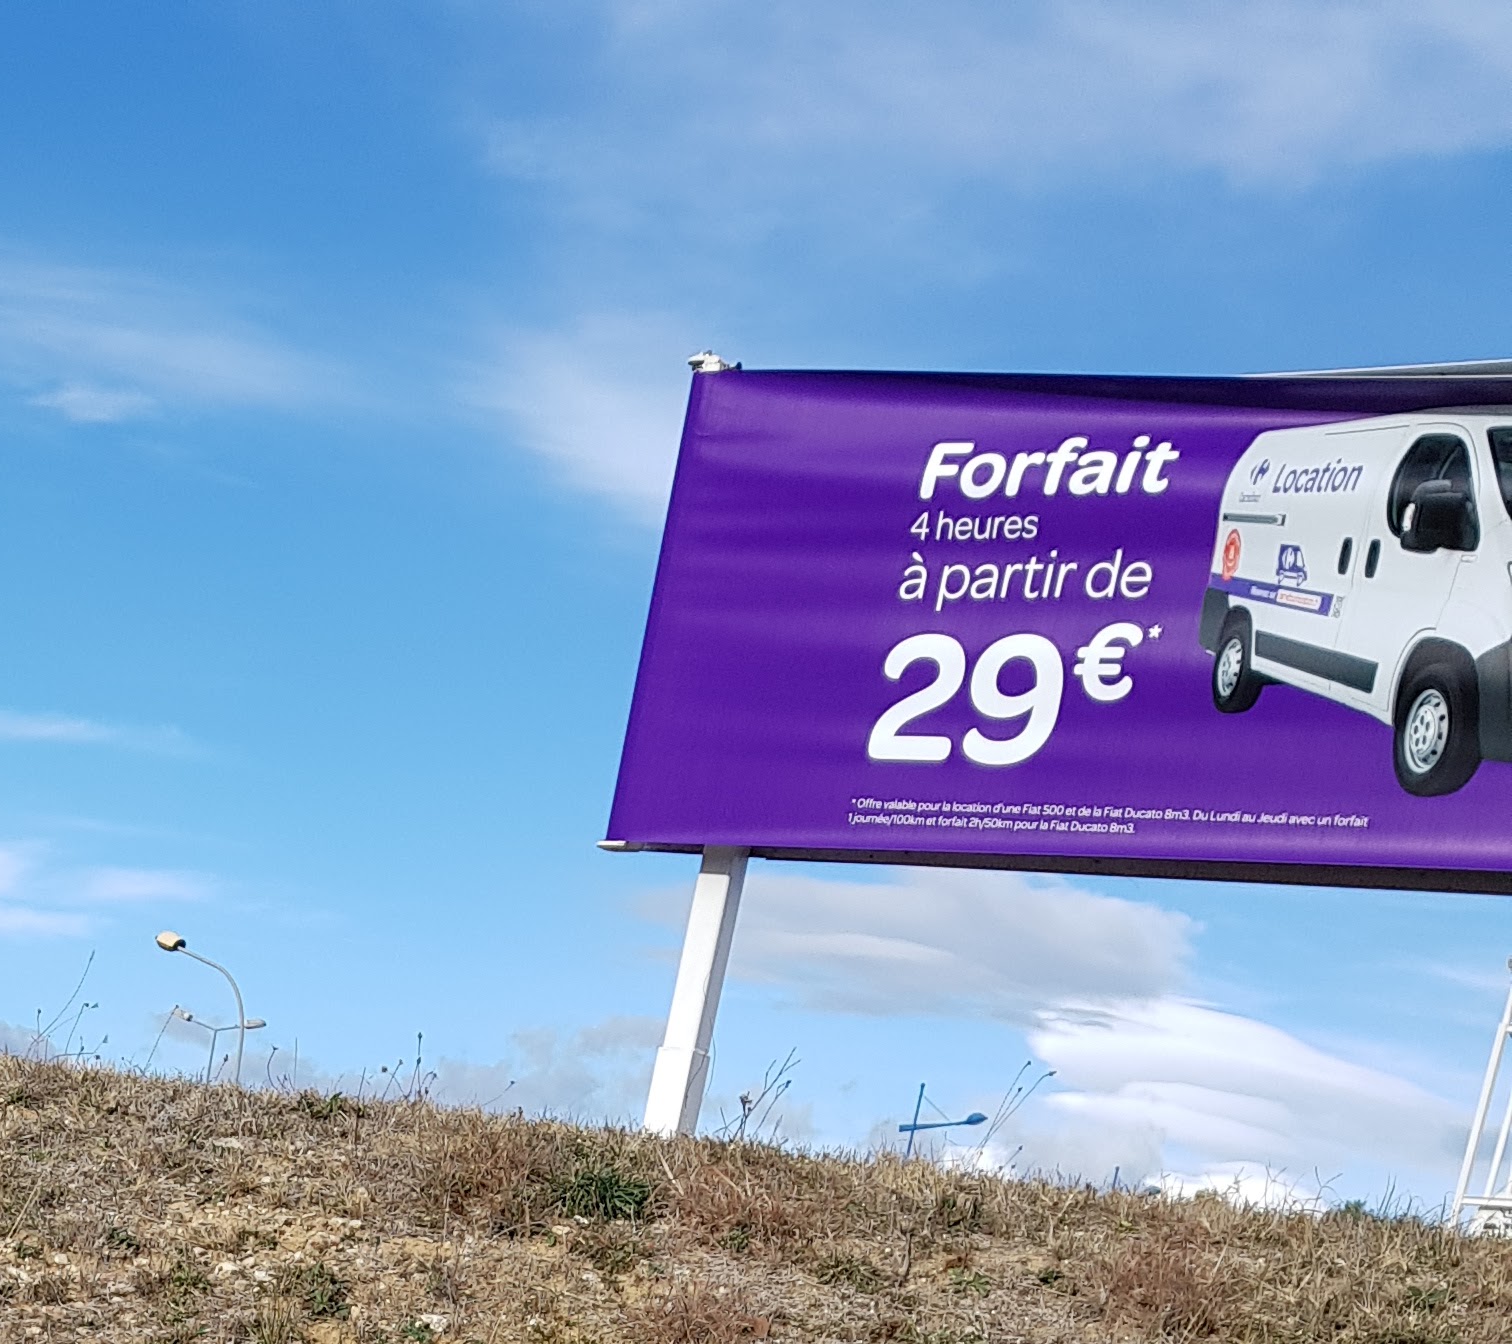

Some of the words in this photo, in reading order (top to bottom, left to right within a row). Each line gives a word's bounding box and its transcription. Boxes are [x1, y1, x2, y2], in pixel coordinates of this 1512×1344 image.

[919, 435, 1180, 500] Forfait
[1272, 458, 1364, 494] Location
[910, 511, 930, 541] 4
[935, 510, 1038, 541] heures
[899, 551, 928, 600] à
[935, 549, 1077, 612] partir
[1085, 548, 1153, 600] de
[917, 802, 942, 813] pour
[942, 801, 951, 812] la
[952, 801, 992, 814] location
[992, 802, 1022, 814] d'une
[1022, 803, 1042, 814] Fiat
[1042, 804, 1065, 816] 500
[1065, 806, 1077, 817] et
[1077, 806, 1091, 817] de
[1093, 806, 1102, 818] la
[1104, 806, 1124, 818] Fiat
[1124, 807, 1163, 820] Ducato
[1192, 809, 1209, 821] Du
[1209, 810, 1241, 823] Lundi
[1241, 813, 1256, 823] au
[1256, 812, 1288, 825] Jeudi
[1288, 815, 1316, 826] avec
[1316, 815, 1332, 826] un
[1333, 815, 1369, 828] forfait
[925, 815, 937, 826] et
[937, 815, 968, 828] forfait
[1013, 820, 1039, 832] pour
[1039, 819, 1049, 831] la
[1049, 820, 1069, 832] Fiat
[1070, 821, 1108, 833] Ducato
